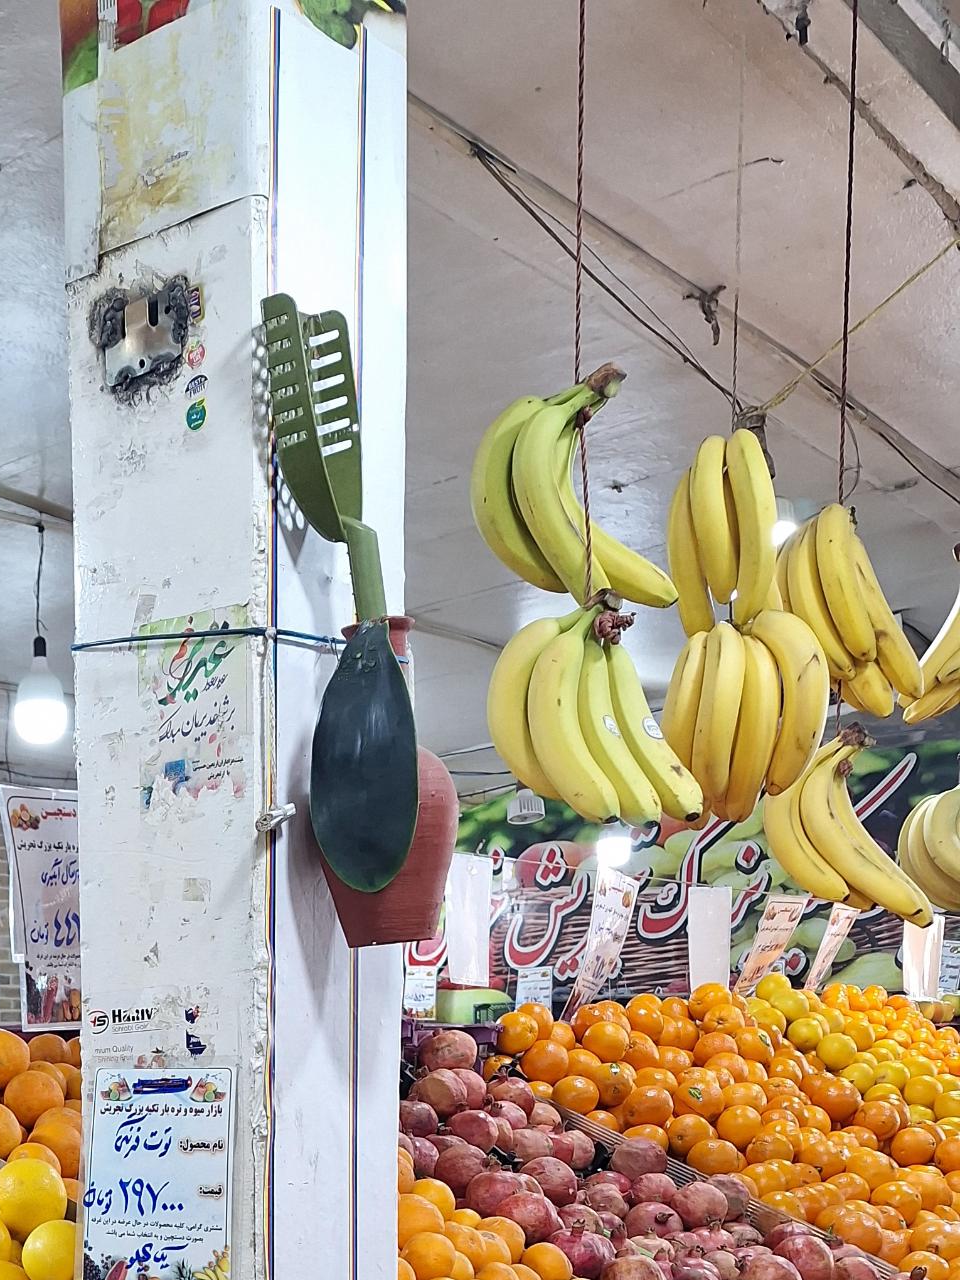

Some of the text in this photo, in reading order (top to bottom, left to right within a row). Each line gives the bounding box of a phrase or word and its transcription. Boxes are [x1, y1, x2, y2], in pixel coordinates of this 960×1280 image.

[100, 1102, 223, 1117] بازار میوه و تره بار تکیه بزرگ تجریش
[180, 1138, 211, 1151] محصول:
[212, 1139, 224, 1152] نام
[199, 1184, 223, 1198] قیمت:
[83, 1181, 113, 1215] تومان
[102, 1217, 111, 1226] این
[117, 1218, 131, 1227] عرضه
[131, 1219, 142, 1227] حال
[150, 1220, 173, 1230] محصولات
[173, 1221, 185, 1230] کلیه
[203, 1225, 223, 1233] مشتری
[126, 1230, 136, 1238] شما
[136, 1231, 153, 1240] انتخاب
[185, 1234, 204, 1244] بصورت
